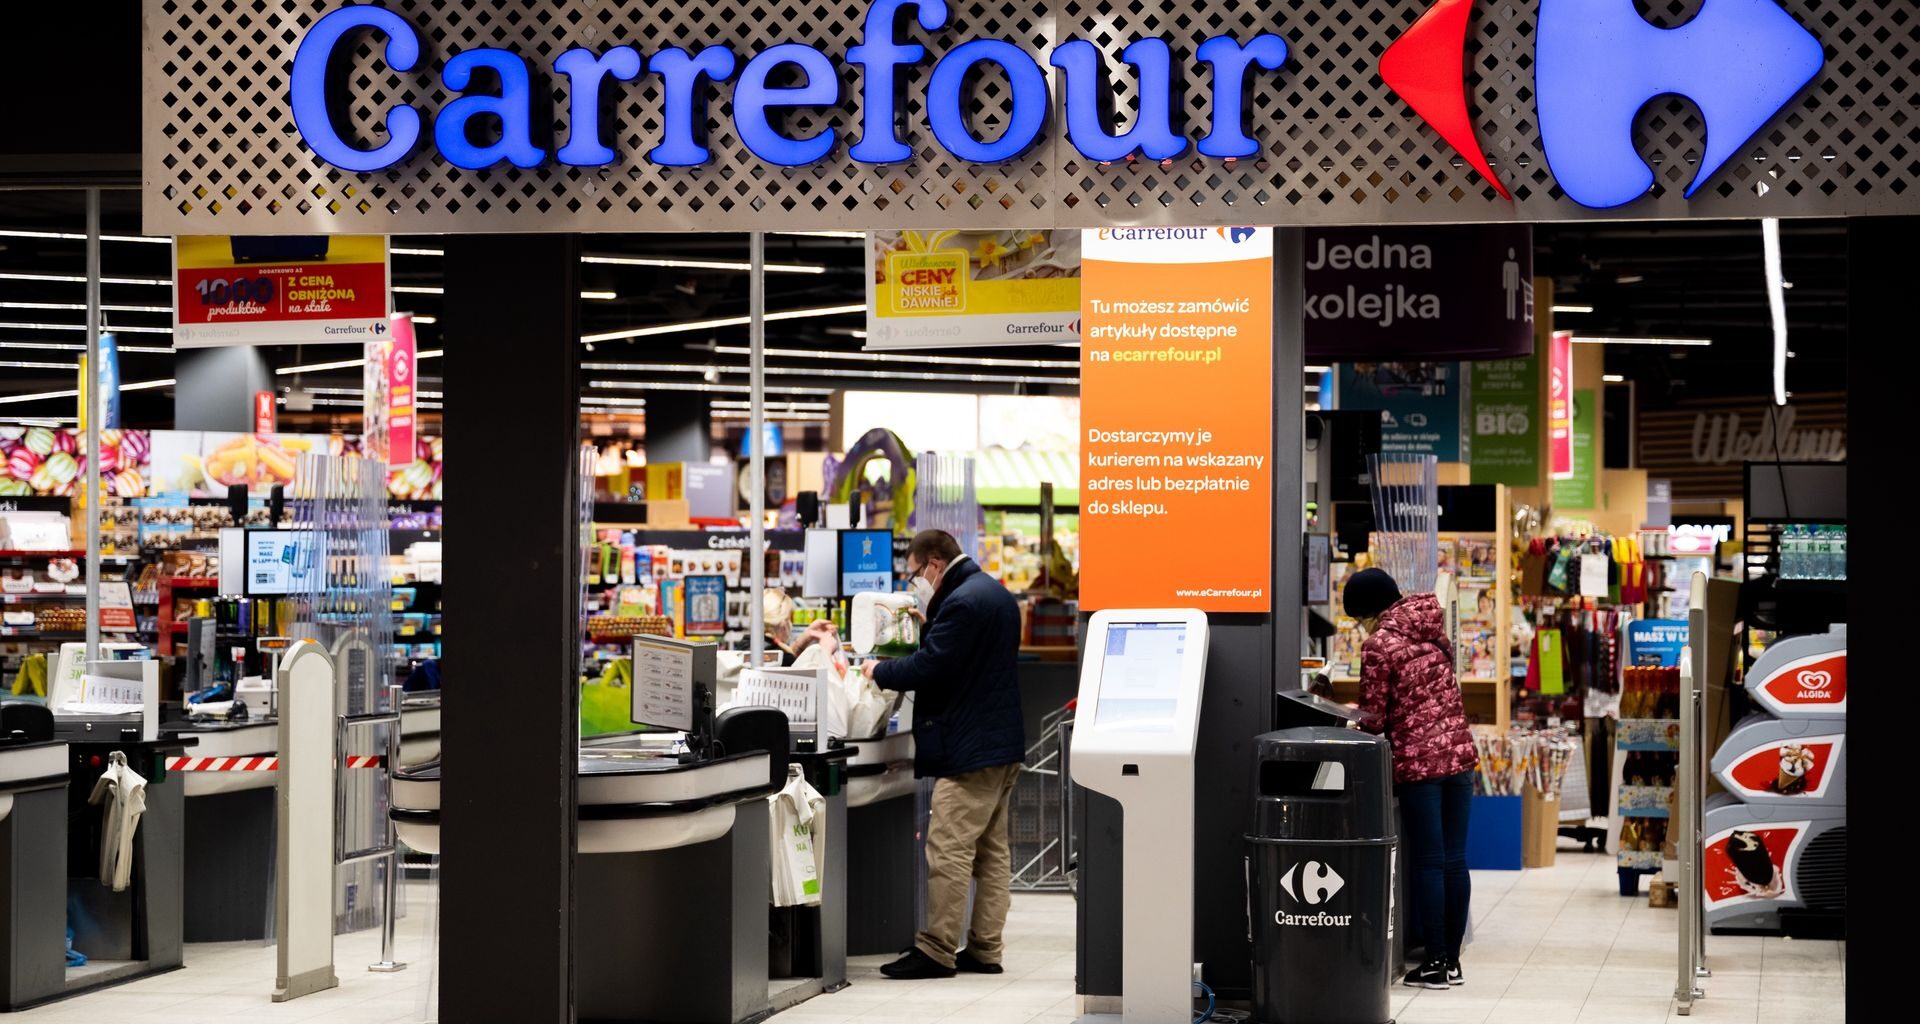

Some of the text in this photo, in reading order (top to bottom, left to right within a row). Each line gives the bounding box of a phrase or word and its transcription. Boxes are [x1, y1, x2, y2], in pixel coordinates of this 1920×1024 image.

[290, 0, 1287, 172] Carrefour
[1305, 234, 1432, 271] Jedna
[287, 275, 335, 287] Z CENĄ
[900, 268, 956, 286] CENY
[195, 277, 274, 304] 1000
[288, 287, 355, 301] OBNIŻONĄ
[900, 286, 942, 297] NISKIE
[207, 301, 266, 321] produktów
[288, 299, 332, 313] na stałe
[1090, 297, 1250, 314] Tu możesz zamówić
[324, 326, 367, 335] Carrefour
[1006, 322, 1065, 335] Carrefour
[1090, 323, 1238, 341] artykuły dostępne
[1090, 346, 1222, 364] na ecarrefour.pl
[1476, 413, 1529, 435] BIO
[1088, 428, 1212, 446] Dostarczymy je
[1088, 452, 1264, 470] kurierem na wskazany
[1087, 475, 1250, 494] adres lub bezpłatnie
[1087, 499, 1168, 518] do sklepu.
[1176, 588, 1262, 599] www.eCarrefour.pl
[1797, 690, 1830, 699] ALGIDA
[1274, 910, 1352, 926] Carrefour
